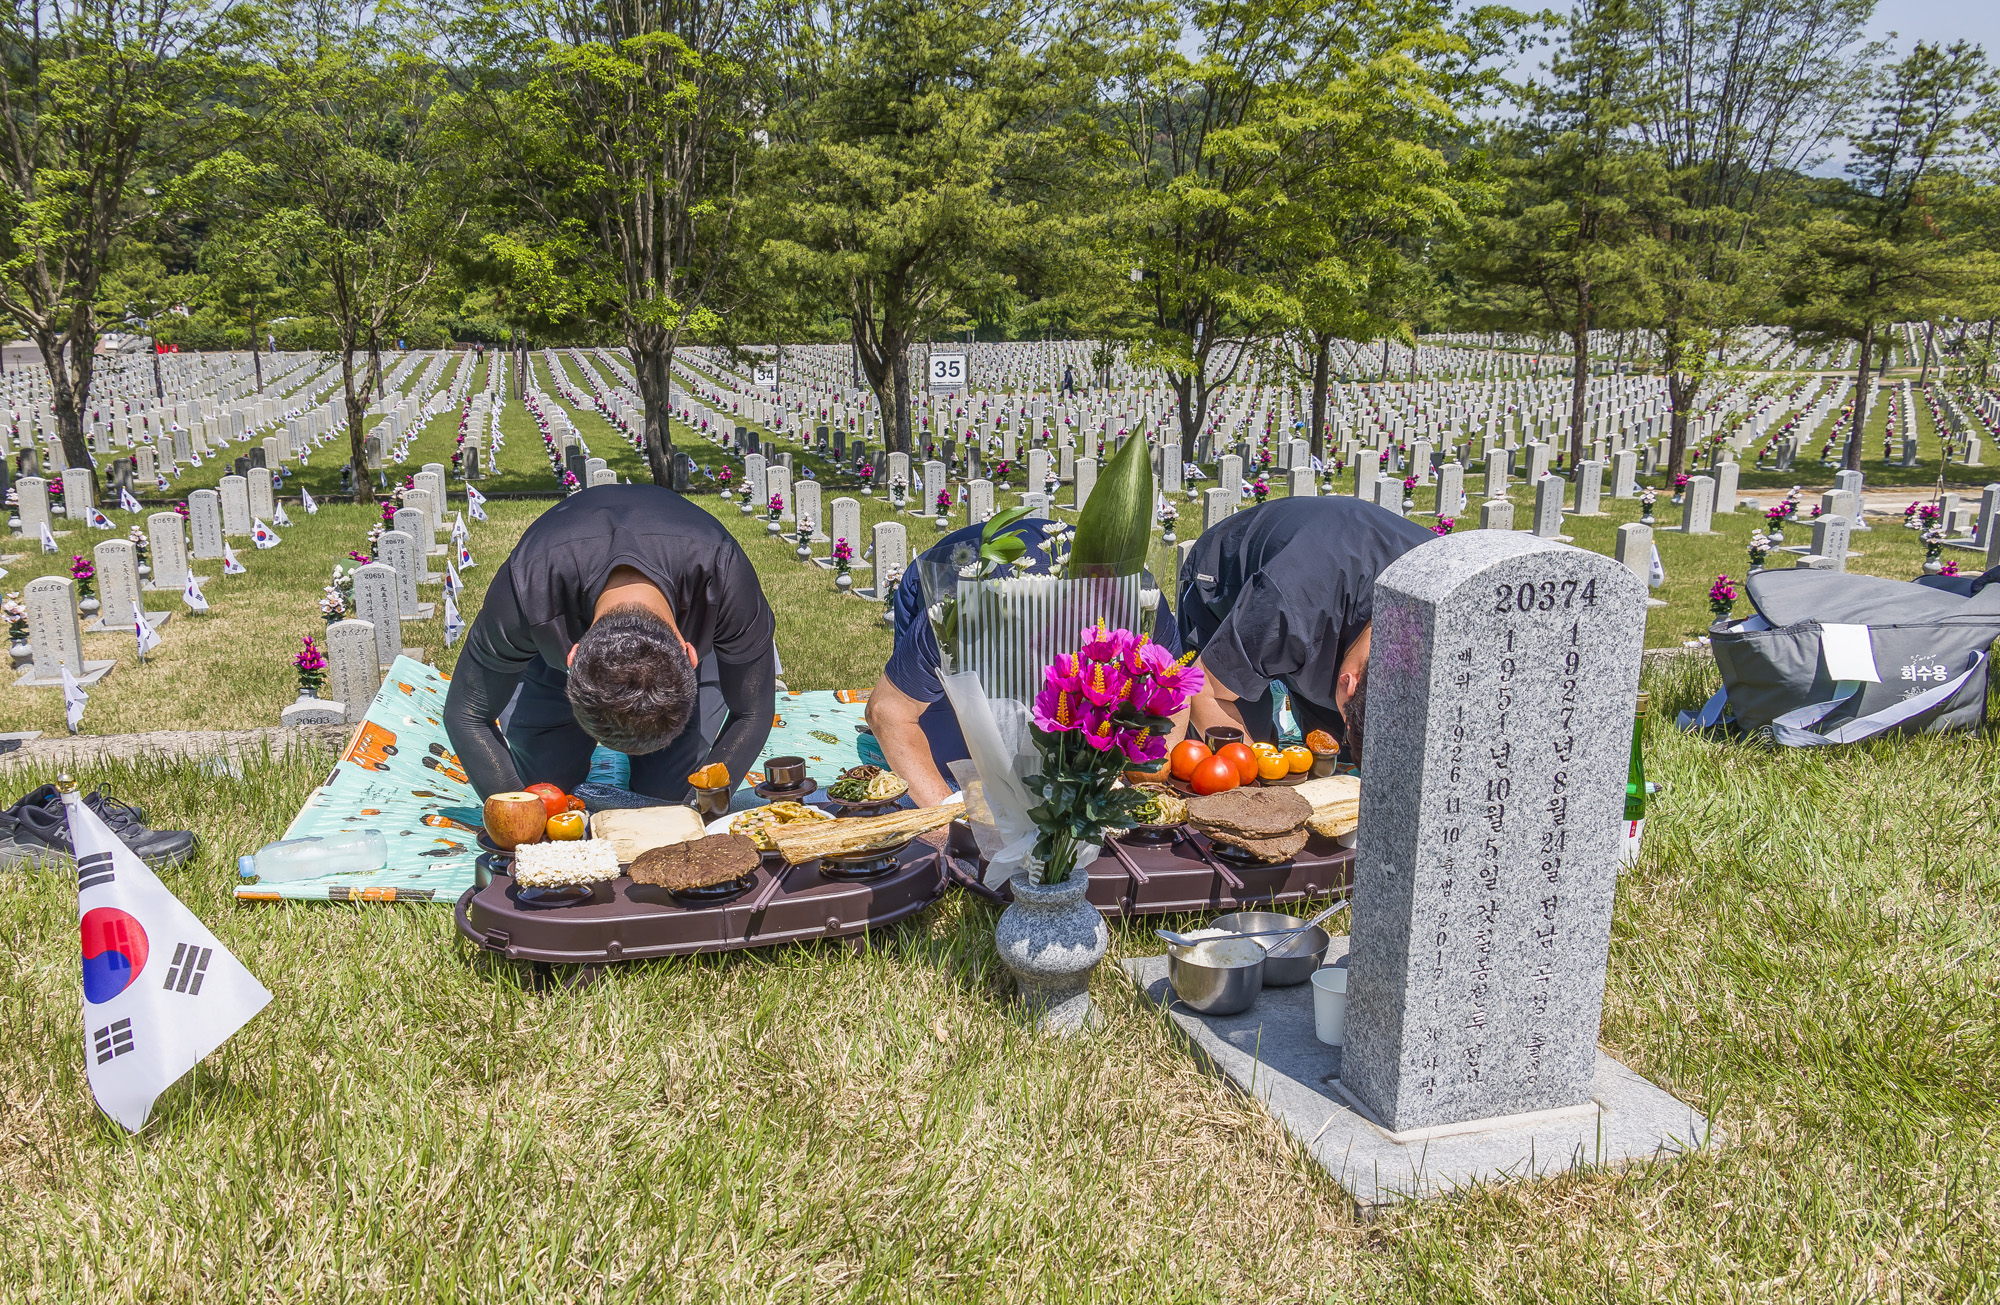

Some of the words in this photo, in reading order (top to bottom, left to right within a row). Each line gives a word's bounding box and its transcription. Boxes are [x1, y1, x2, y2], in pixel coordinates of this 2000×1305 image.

[757, 367, 774, 381] 34
[934, 360, 961, 378] 35
[100, 546, 126, 554] 20674
[363, 572, 385, 580] 20651
[1495, 579, 1598, 613] 20374
[1901, 665, 1948, 682] 회수용
